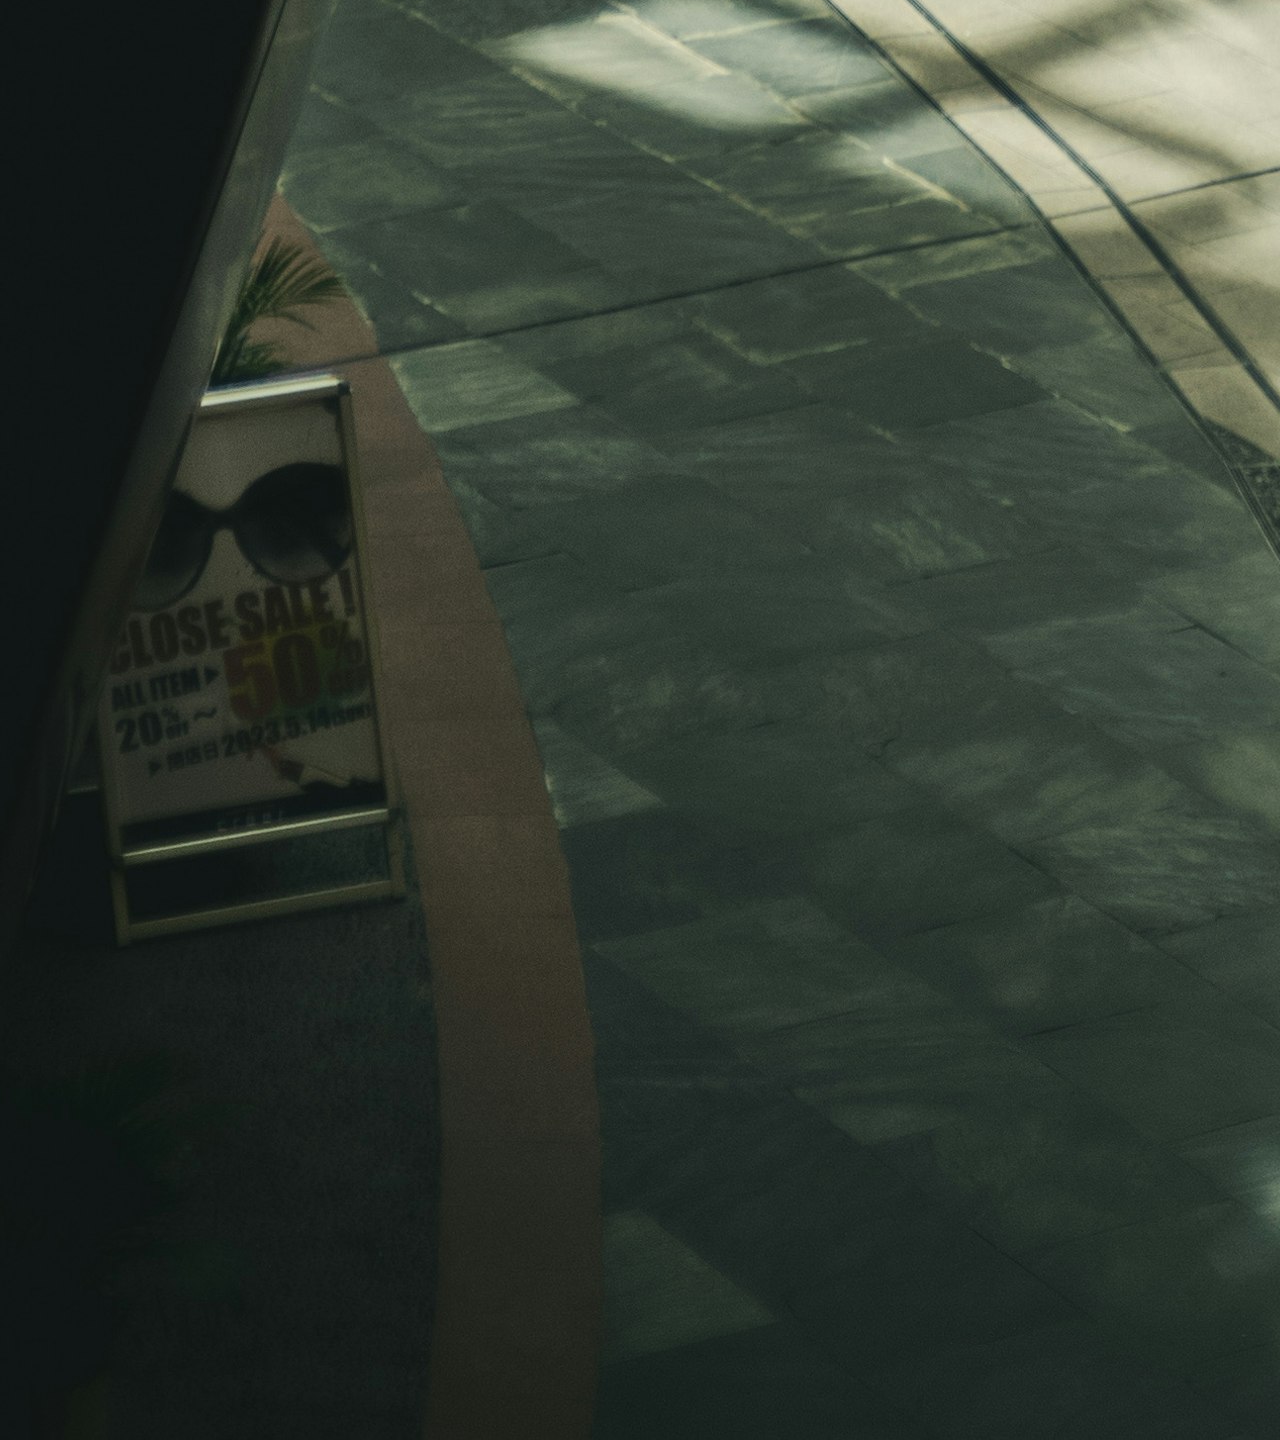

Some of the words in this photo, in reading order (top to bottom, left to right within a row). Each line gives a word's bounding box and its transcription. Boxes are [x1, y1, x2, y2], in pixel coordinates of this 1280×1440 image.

[110, 597, 230, 675] CLOSE
[111, 681, 146, 711] ALL
[150, 666, 201, 703] ITEM
